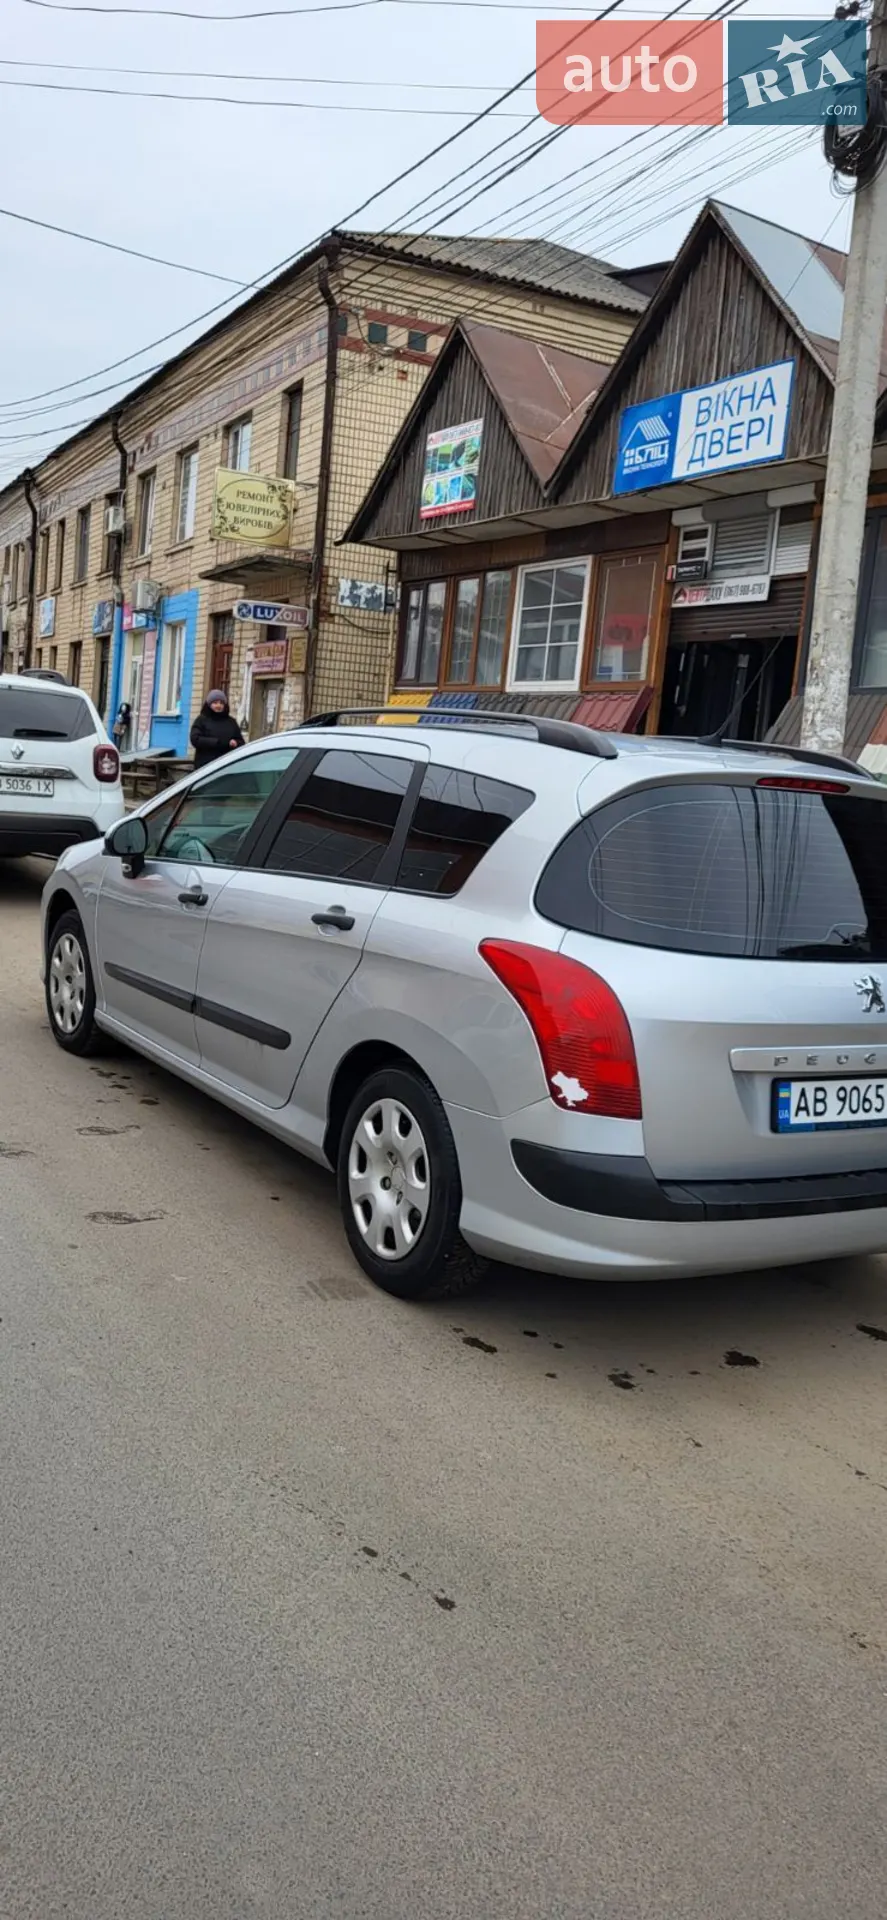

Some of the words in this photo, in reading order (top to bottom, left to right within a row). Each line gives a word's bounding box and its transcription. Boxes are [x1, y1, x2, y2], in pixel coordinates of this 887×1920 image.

[695, 377, 777, 428] ВІКНА
[687, 414, 774, 471] ДВЕРІ
[236, 489, 274, 503] РЕМОНТ
[225, 501, 281, 518] ЮВЕЛІРНИХ
[233, 516, 273, 530] ВИРОБІВ
[256, 607, 305, 622] LUXOIL
[5, 778, 32, 791] 5036
[794, 1086, 828, 1118] AB
[836, 1084, 886, 1117] 9065
[778, 1109, 790, 1119] UA
